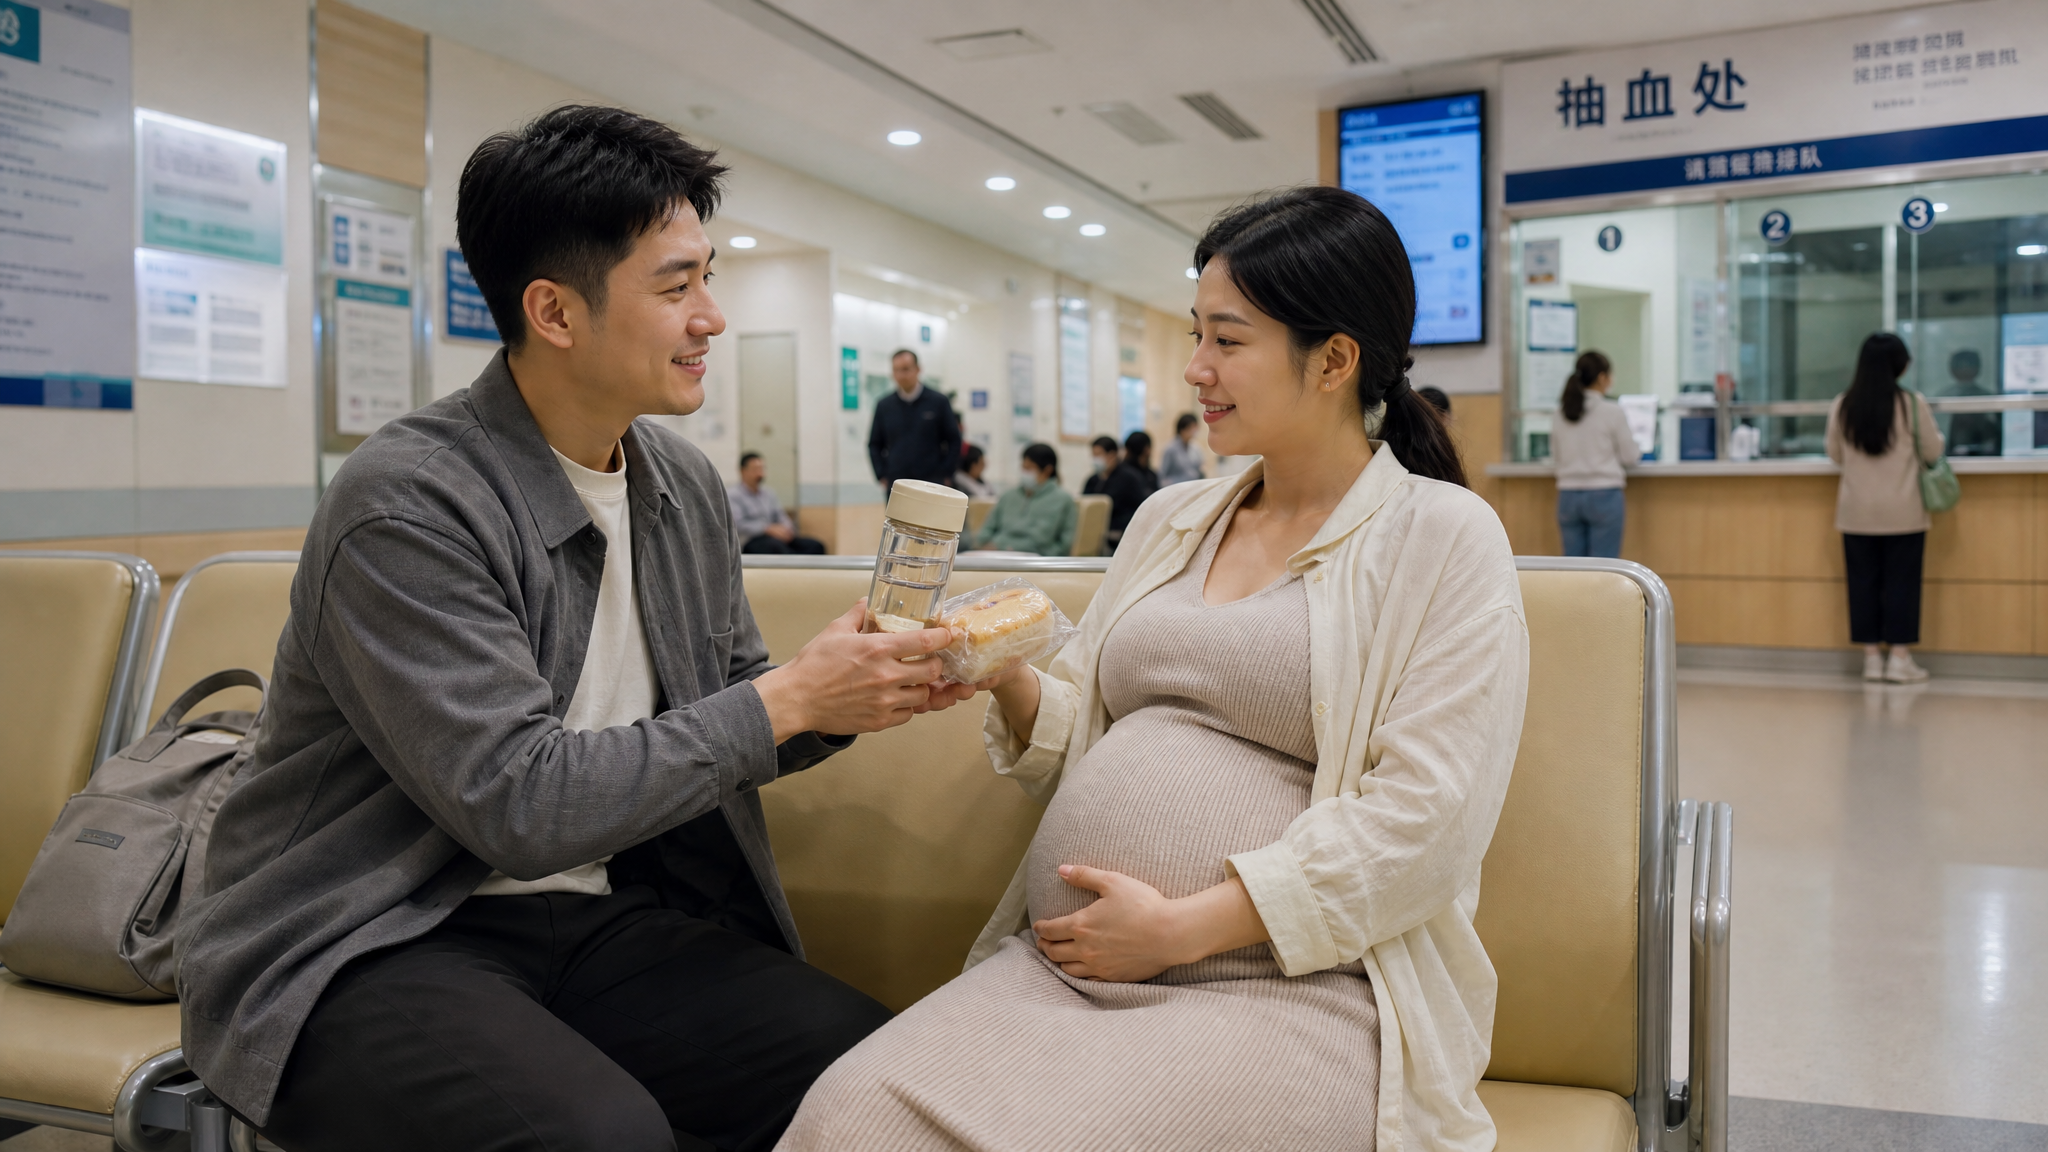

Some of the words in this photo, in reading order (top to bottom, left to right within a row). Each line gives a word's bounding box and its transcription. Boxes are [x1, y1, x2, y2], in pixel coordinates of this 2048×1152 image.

[1556, 58, 1747, 128] 抽血处
[1766, 213, 1785, 239] 2
[1908, 200, 1928, 228] 3
[1603, 227, 1616, 249] 1
